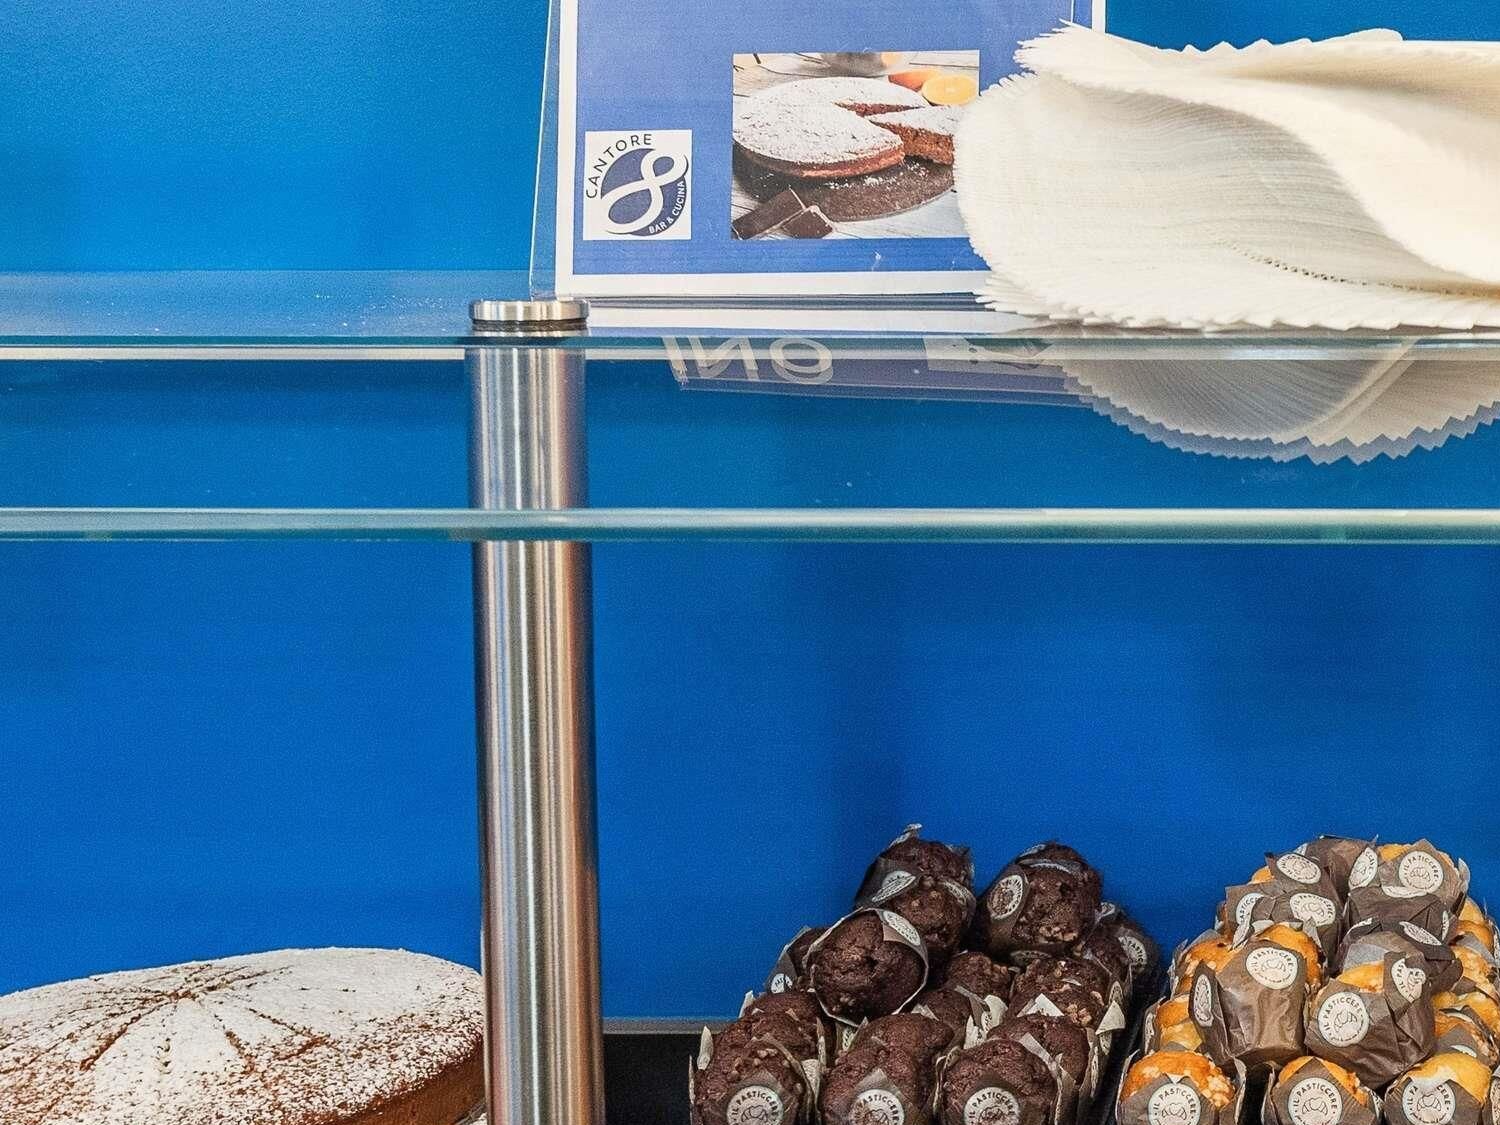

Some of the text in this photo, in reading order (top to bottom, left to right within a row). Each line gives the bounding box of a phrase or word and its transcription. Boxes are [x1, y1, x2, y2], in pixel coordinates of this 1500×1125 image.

[586, 133, 653, 199] CANTORE
[648, 221, 667, 234] BAR
[671, 181, 686, 216] CUCINA
[1324, 997, 1363, 1021] PASTICCERE
[738, 1090, 780, 1116] PASTICCERE
[1158, 1087, 1197, 1115] PASTICCERE
[1296, 1082, 1338, 1110] PASTICCERE
